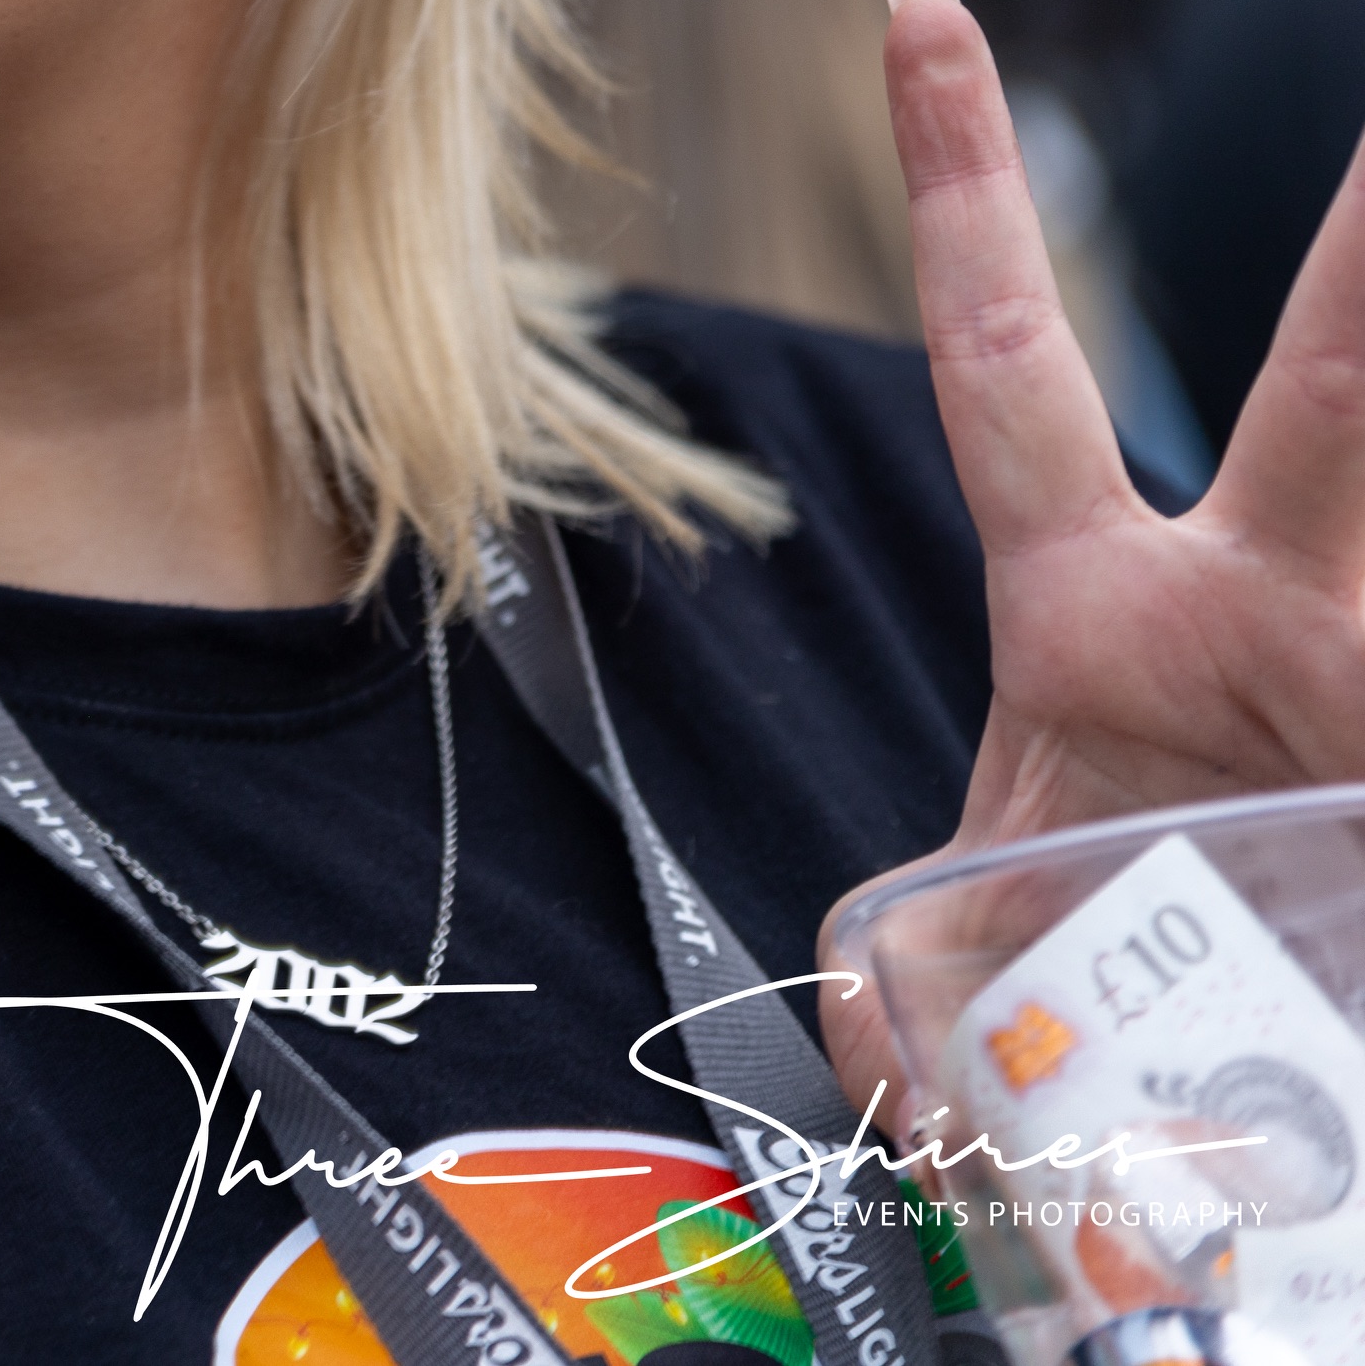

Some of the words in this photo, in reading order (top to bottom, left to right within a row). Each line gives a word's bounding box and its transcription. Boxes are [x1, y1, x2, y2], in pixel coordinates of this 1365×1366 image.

[200, 931, 419, 1045] 2002
[1091, 902, 1212, 1033] £10
[835, 1285, 907, 1366] LIG
